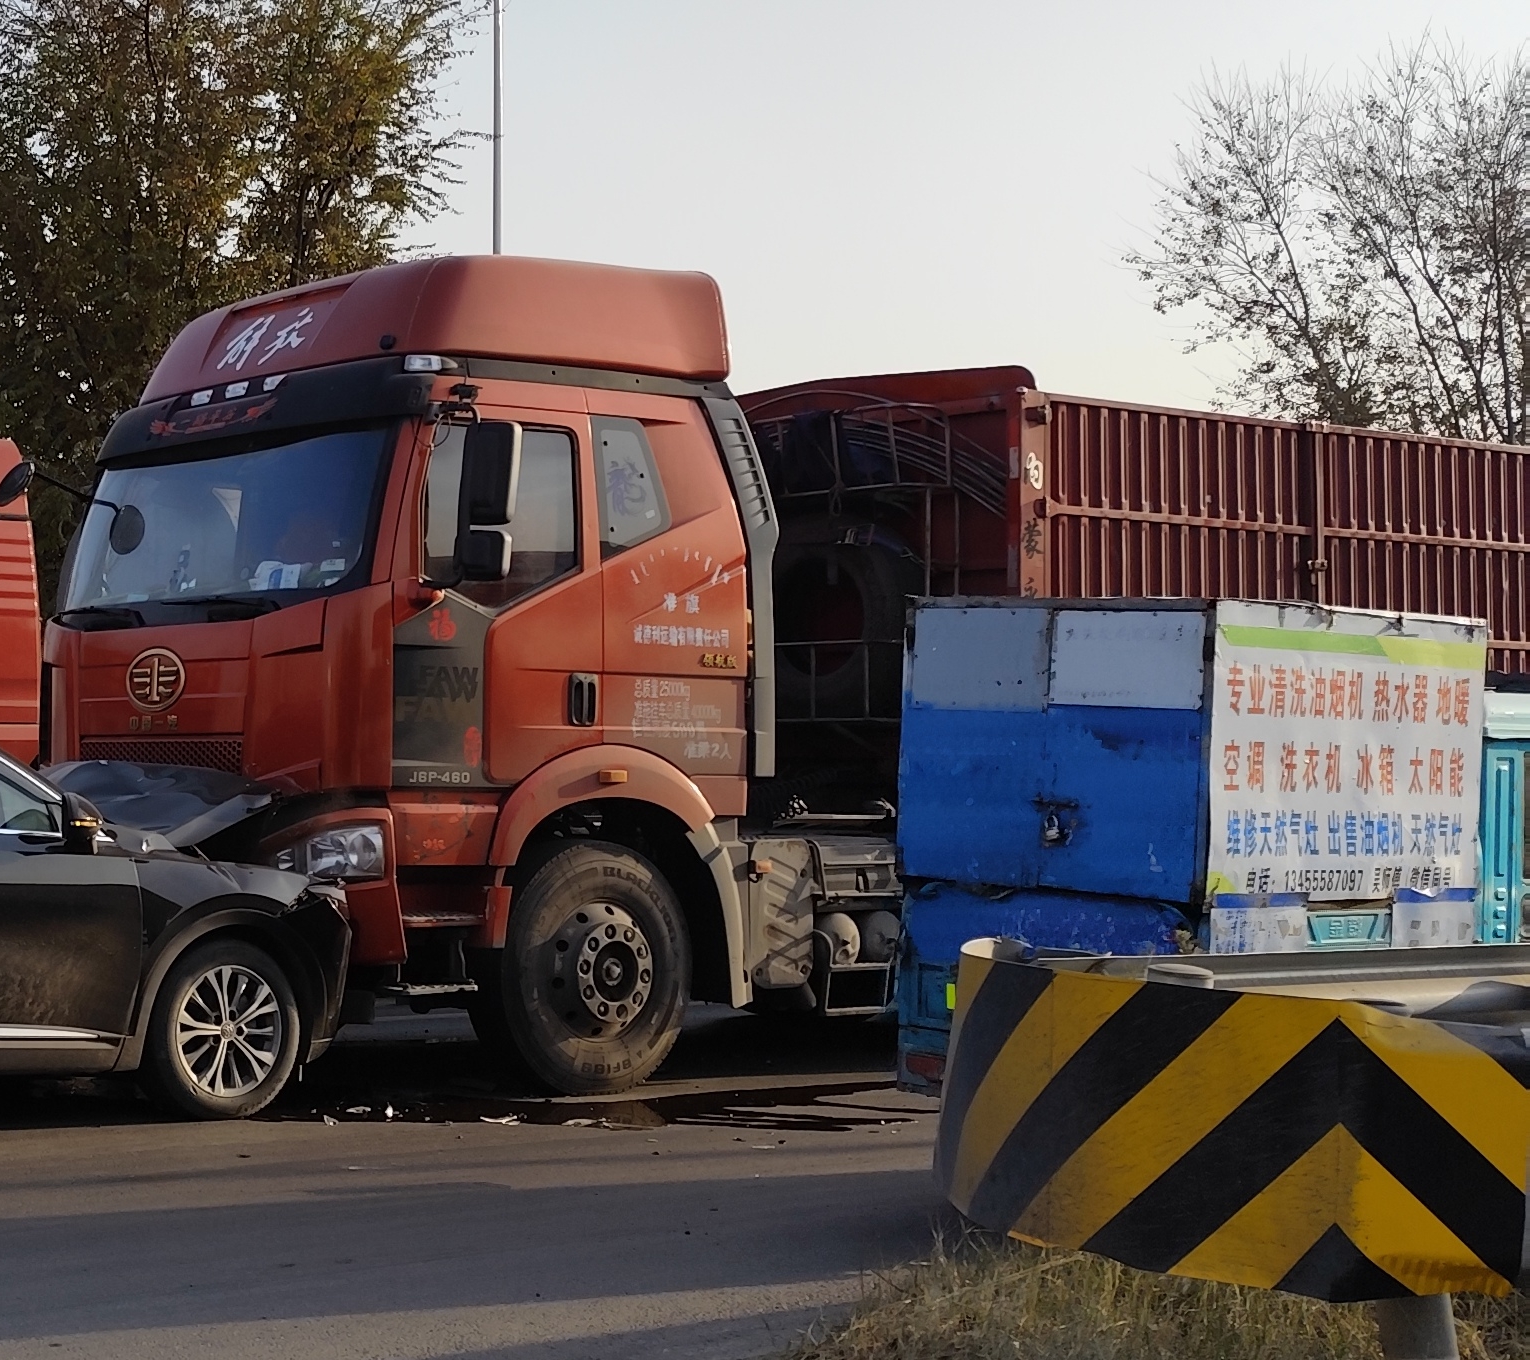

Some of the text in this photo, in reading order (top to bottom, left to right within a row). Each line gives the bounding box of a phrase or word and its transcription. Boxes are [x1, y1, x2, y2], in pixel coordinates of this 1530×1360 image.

[217, 307, 314, 371] 解放
[1227, 661, 1471, 727] 专业清洗油烟机 热水器 地暖
[409, 771, 471, 784] J6P-460
[1223, 739, 1464, 797] 空调 洗衣机 冰箱 太阳能
[1226, 808, 1463, 858] 维修天然气灶 出售油烟机 天然气灶
[1284, 869, 1364, 891] 13455587097
